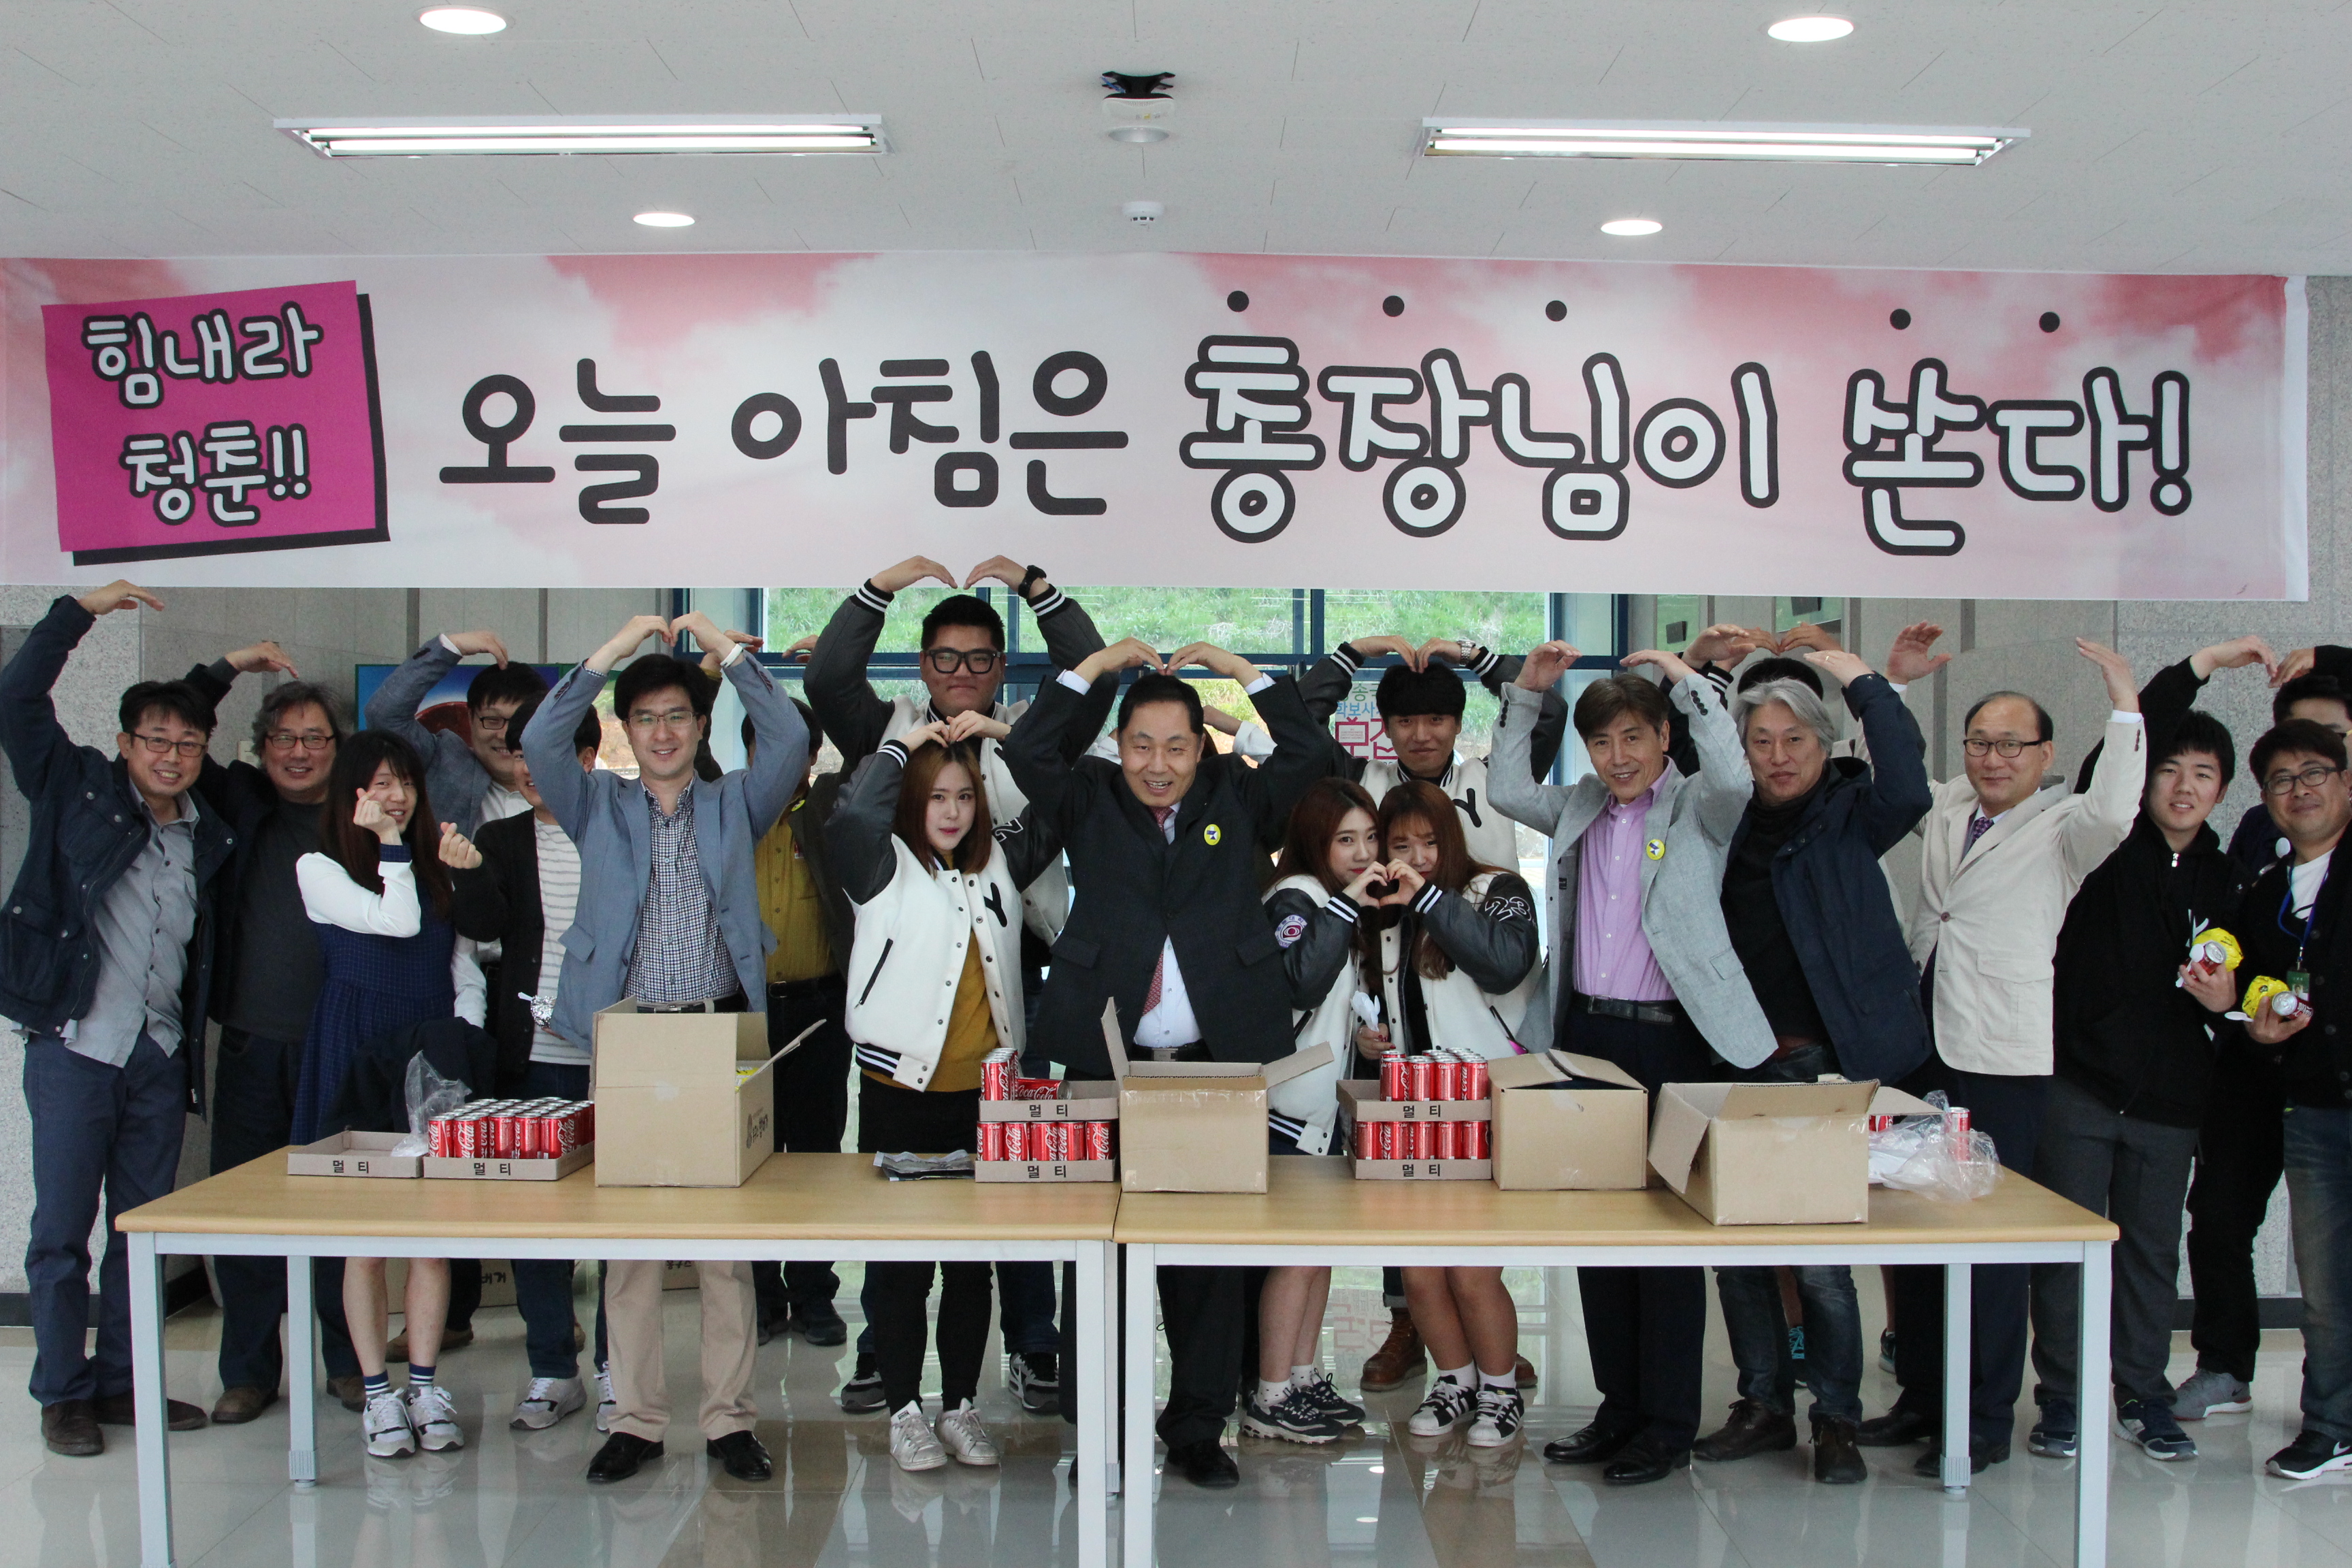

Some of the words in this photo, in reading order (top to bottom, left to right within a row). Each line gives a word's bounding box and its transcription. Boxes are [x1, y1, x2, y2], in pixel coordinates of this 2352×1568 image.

[81, 301, 323, 408] 힘내라
[119, 420, 312, 527] 청춘!!
[439, 358, 676, 524] 오늘
[731, 350, 1128, 515] 아침은
[1179, 335, 1778, 543] 총장님이
[1842, 357, 2192, 555] 쏜다!
[1337, 701, 1380, 718] 학보사
